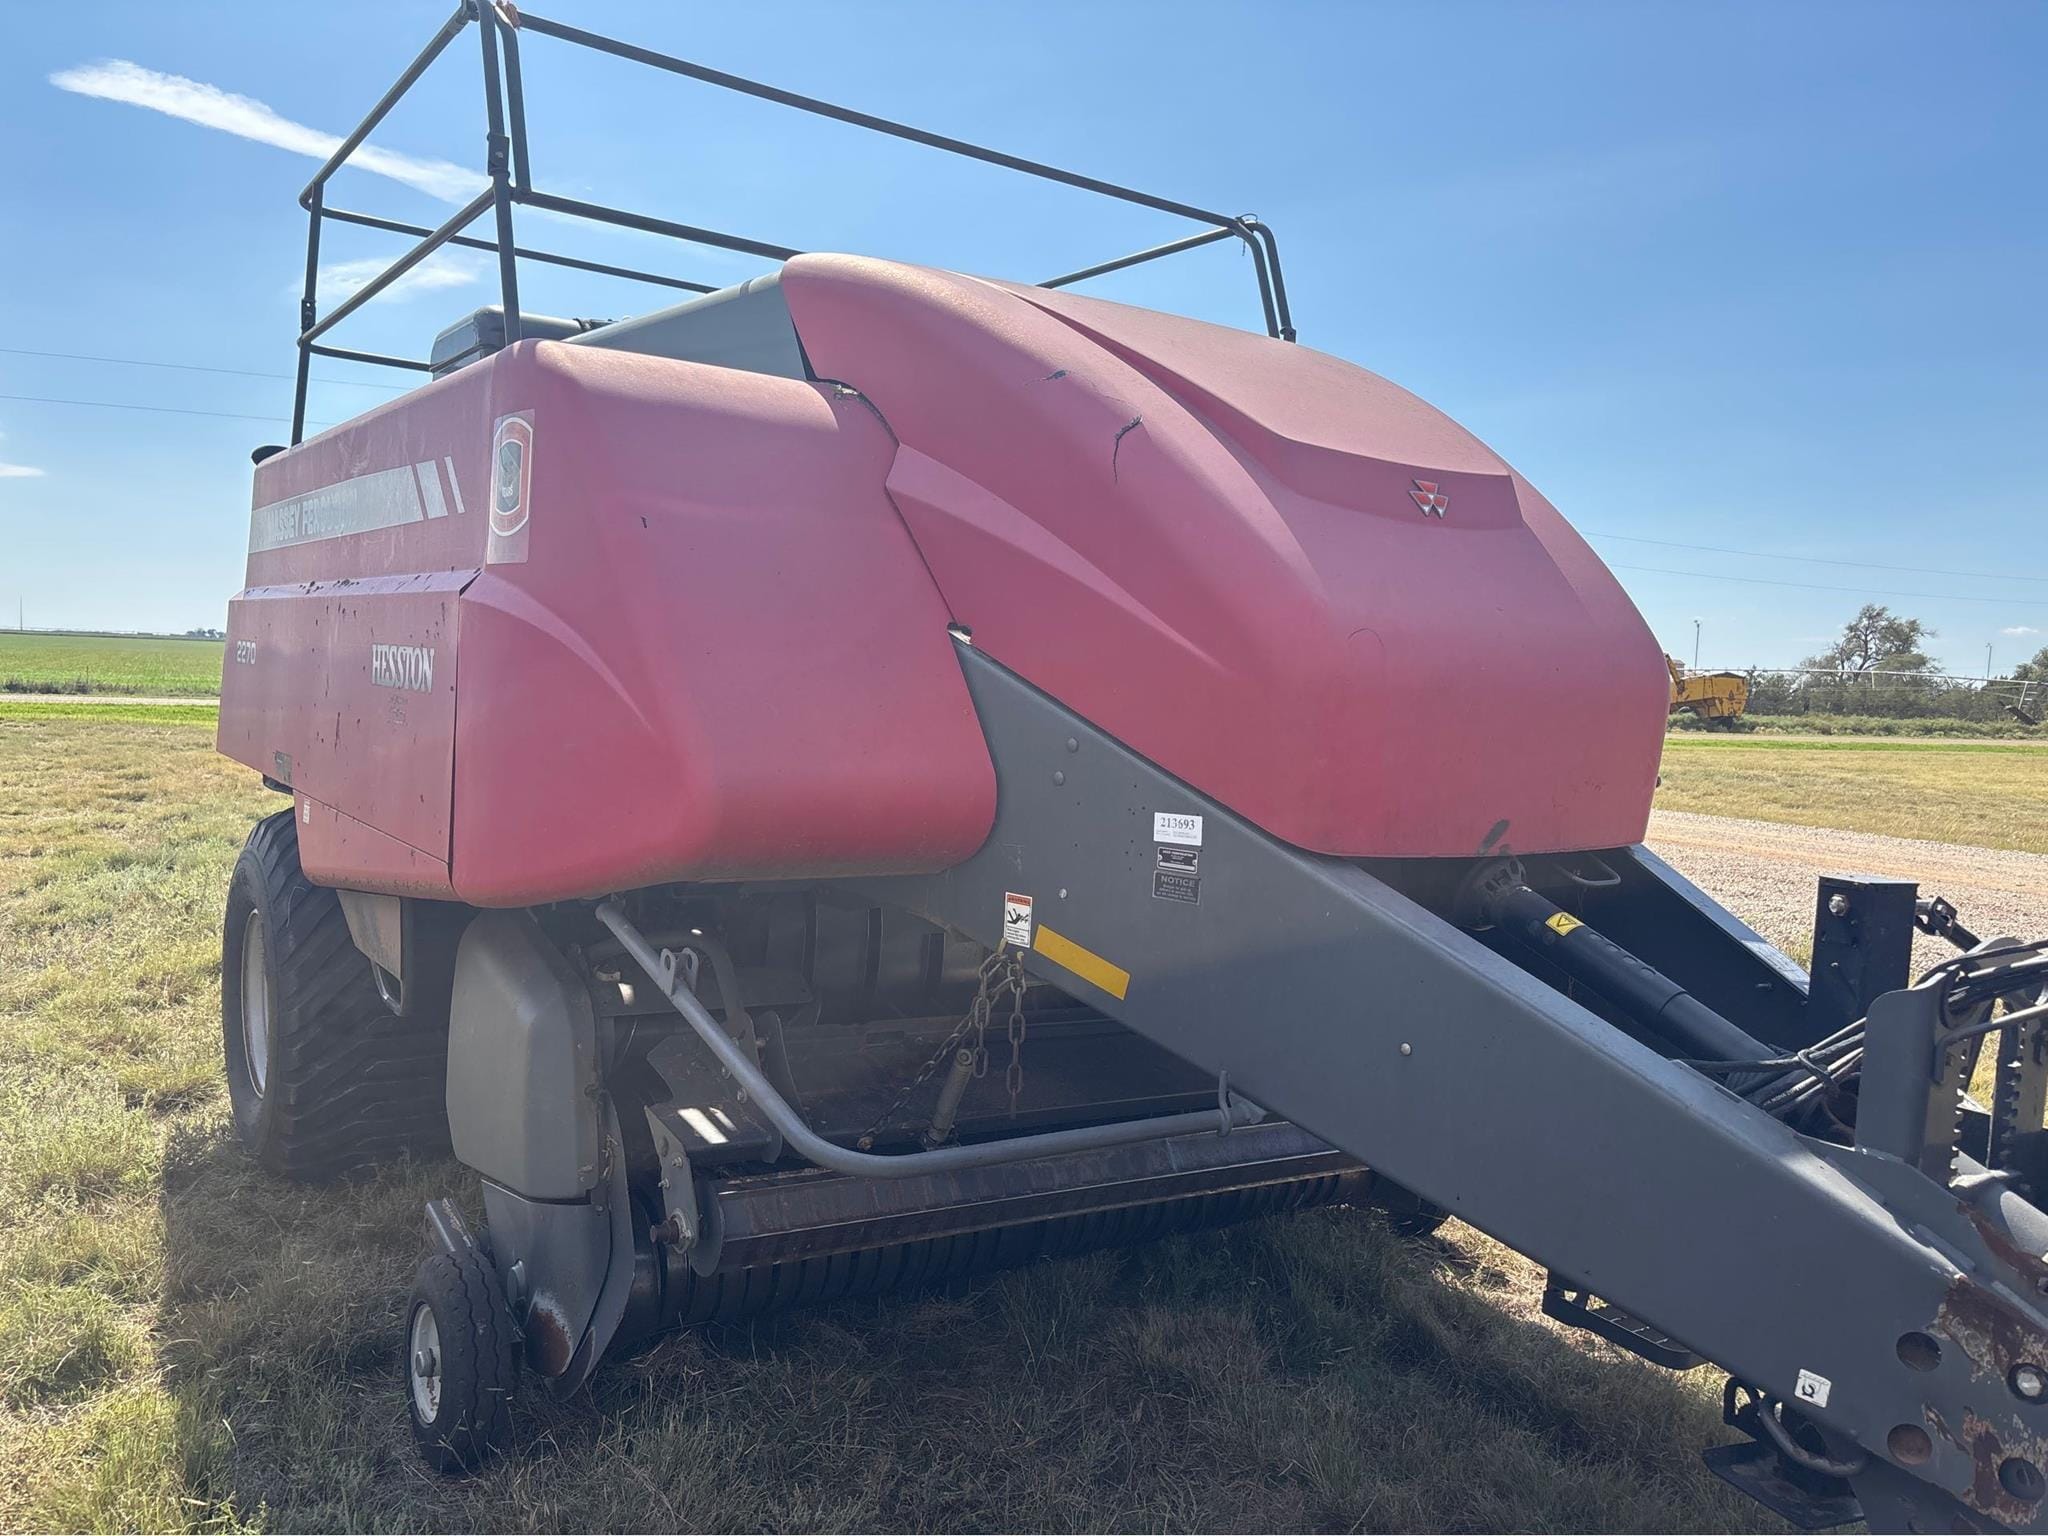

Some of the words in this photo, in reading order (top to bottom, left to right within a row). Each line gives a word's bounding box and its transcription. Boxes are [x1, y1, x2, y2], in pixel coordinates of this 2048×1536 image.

[236, 640, 257, 665] 2270
[371, 643, 435, 693] HESSTON
[1160, 817, 1195, 830] 213693
[1160, 875, 1195, 887] NOTICE
